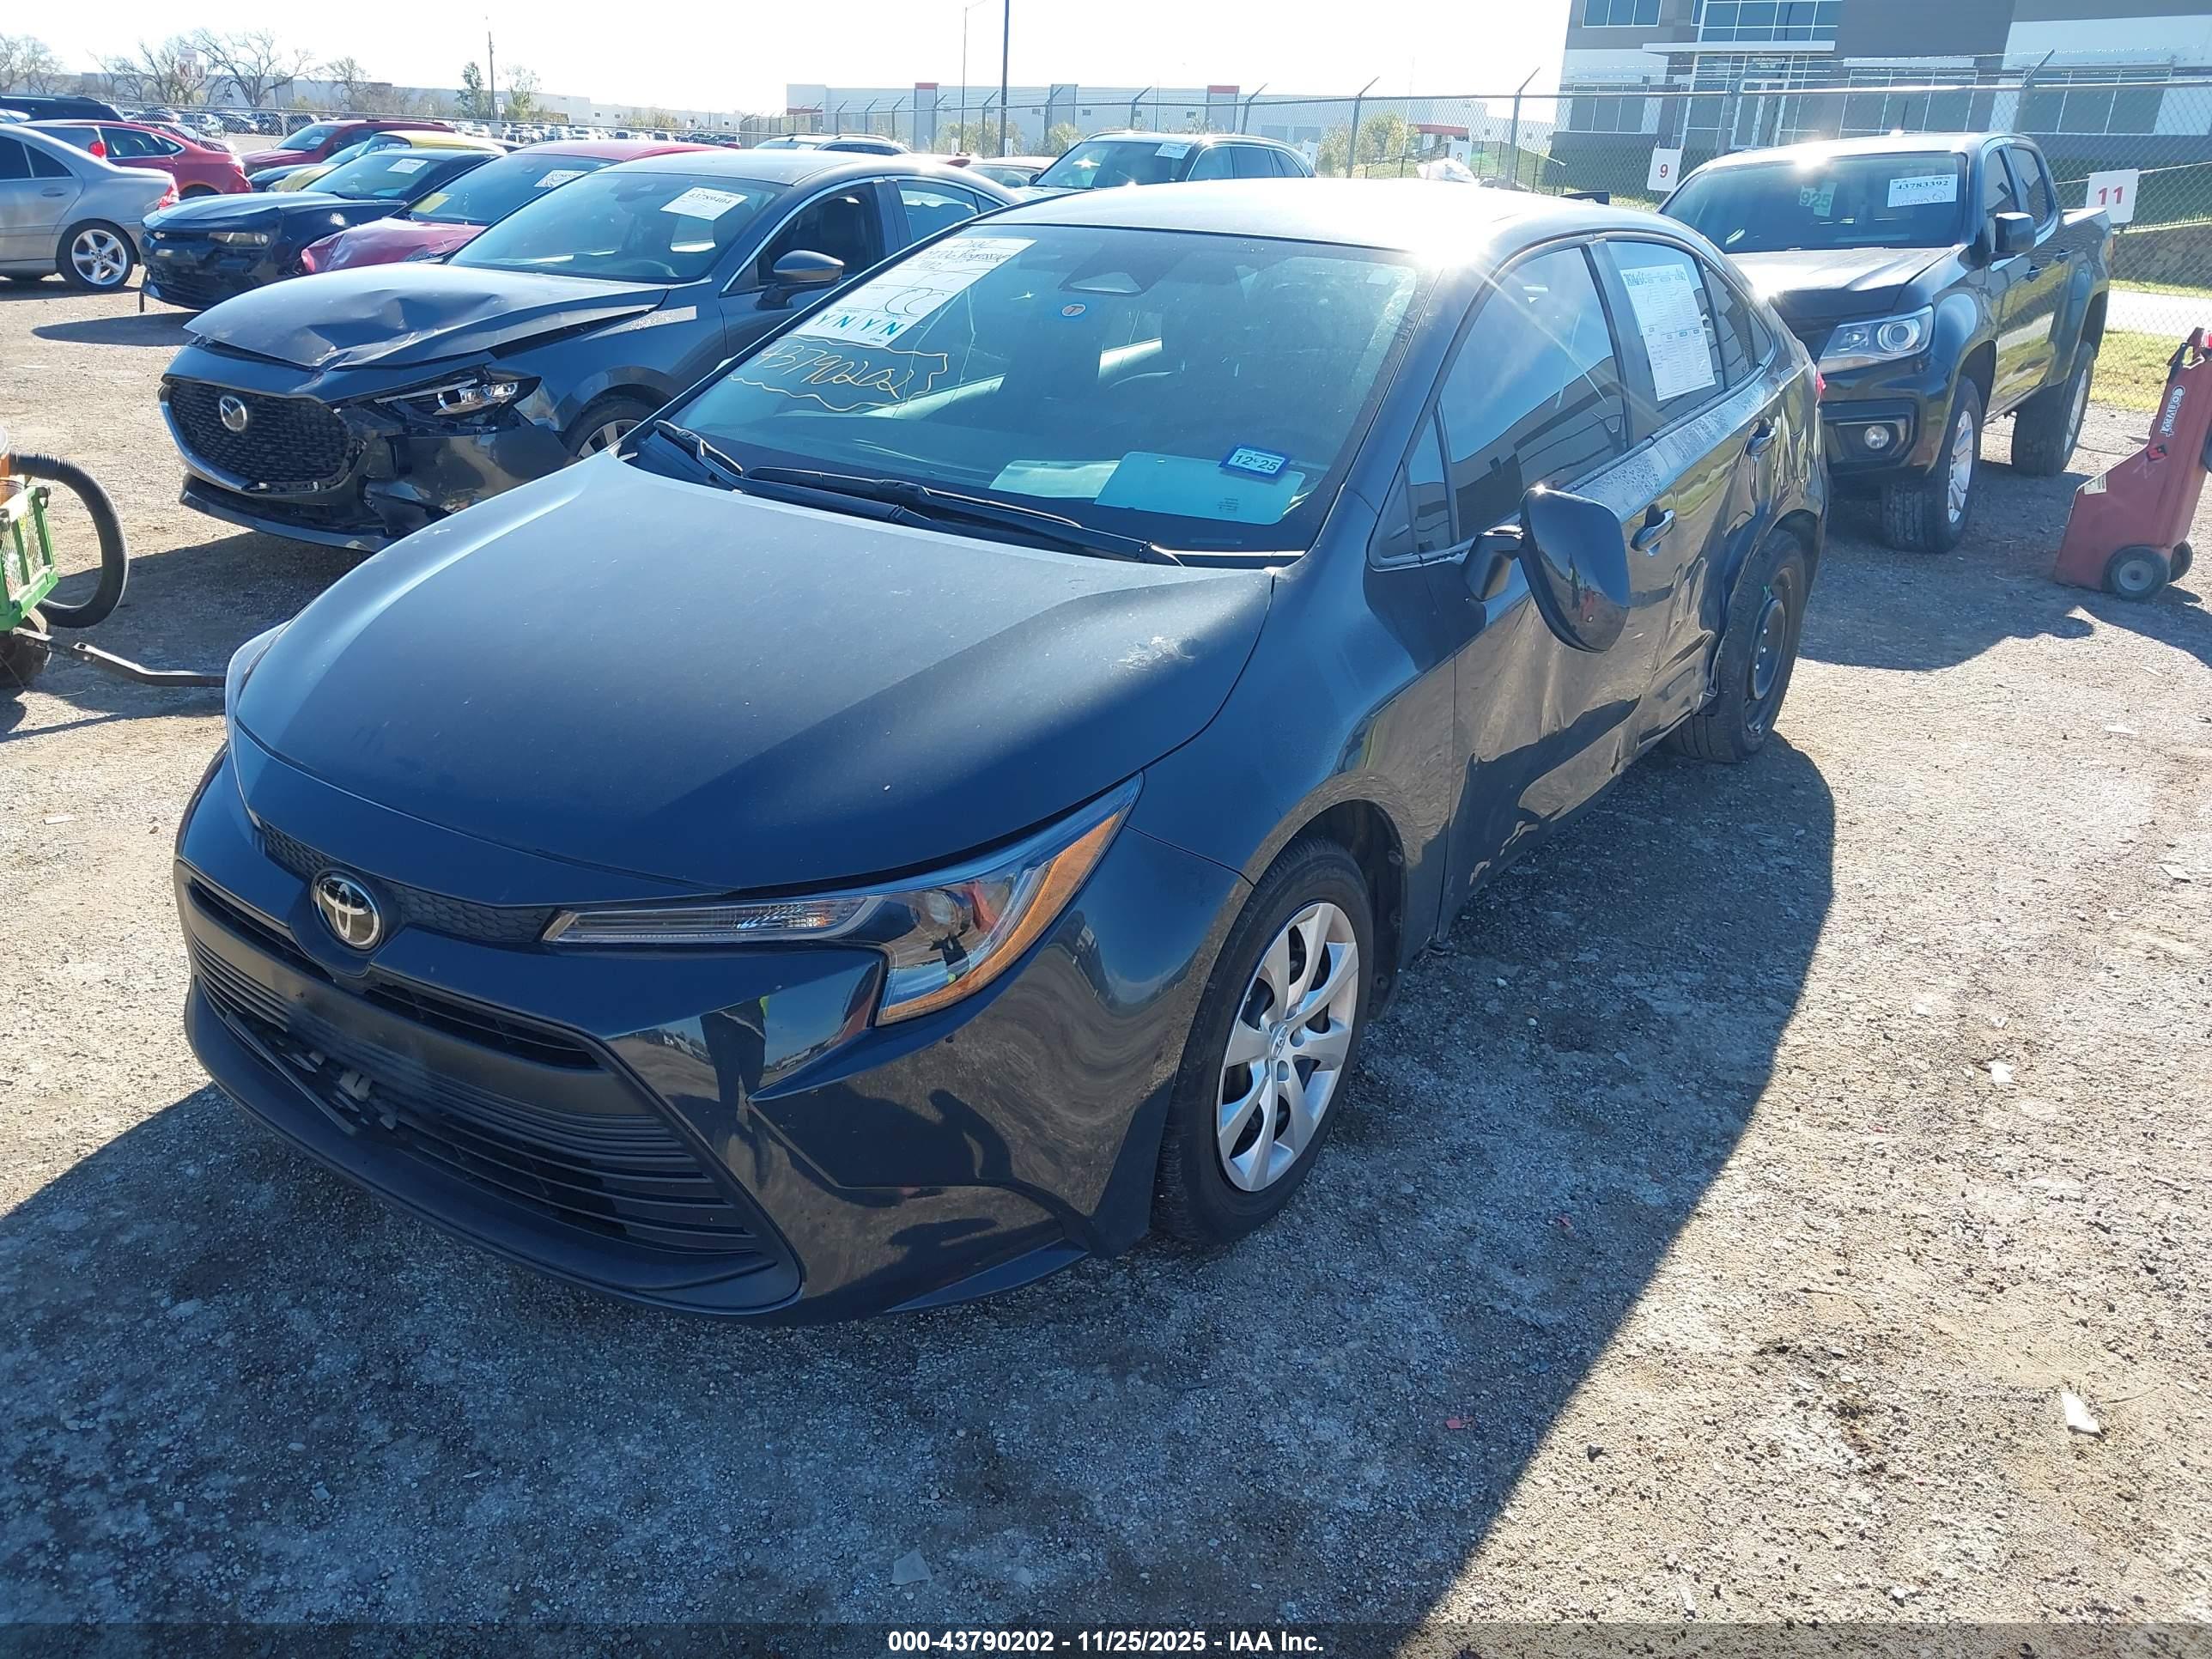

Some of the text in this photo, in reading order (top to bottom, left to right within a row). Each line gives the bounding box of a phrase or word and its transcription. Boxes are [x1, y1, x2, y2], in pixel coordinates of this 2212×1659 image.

[1660, 163, 1668, 179] 9
[1895, 179, 1949, 191] 43783392
[1801, 191, 1832, 209] 925
[2098, 185, 2124, 206] 11
[1235, 454, 1279, 471] 12 25
